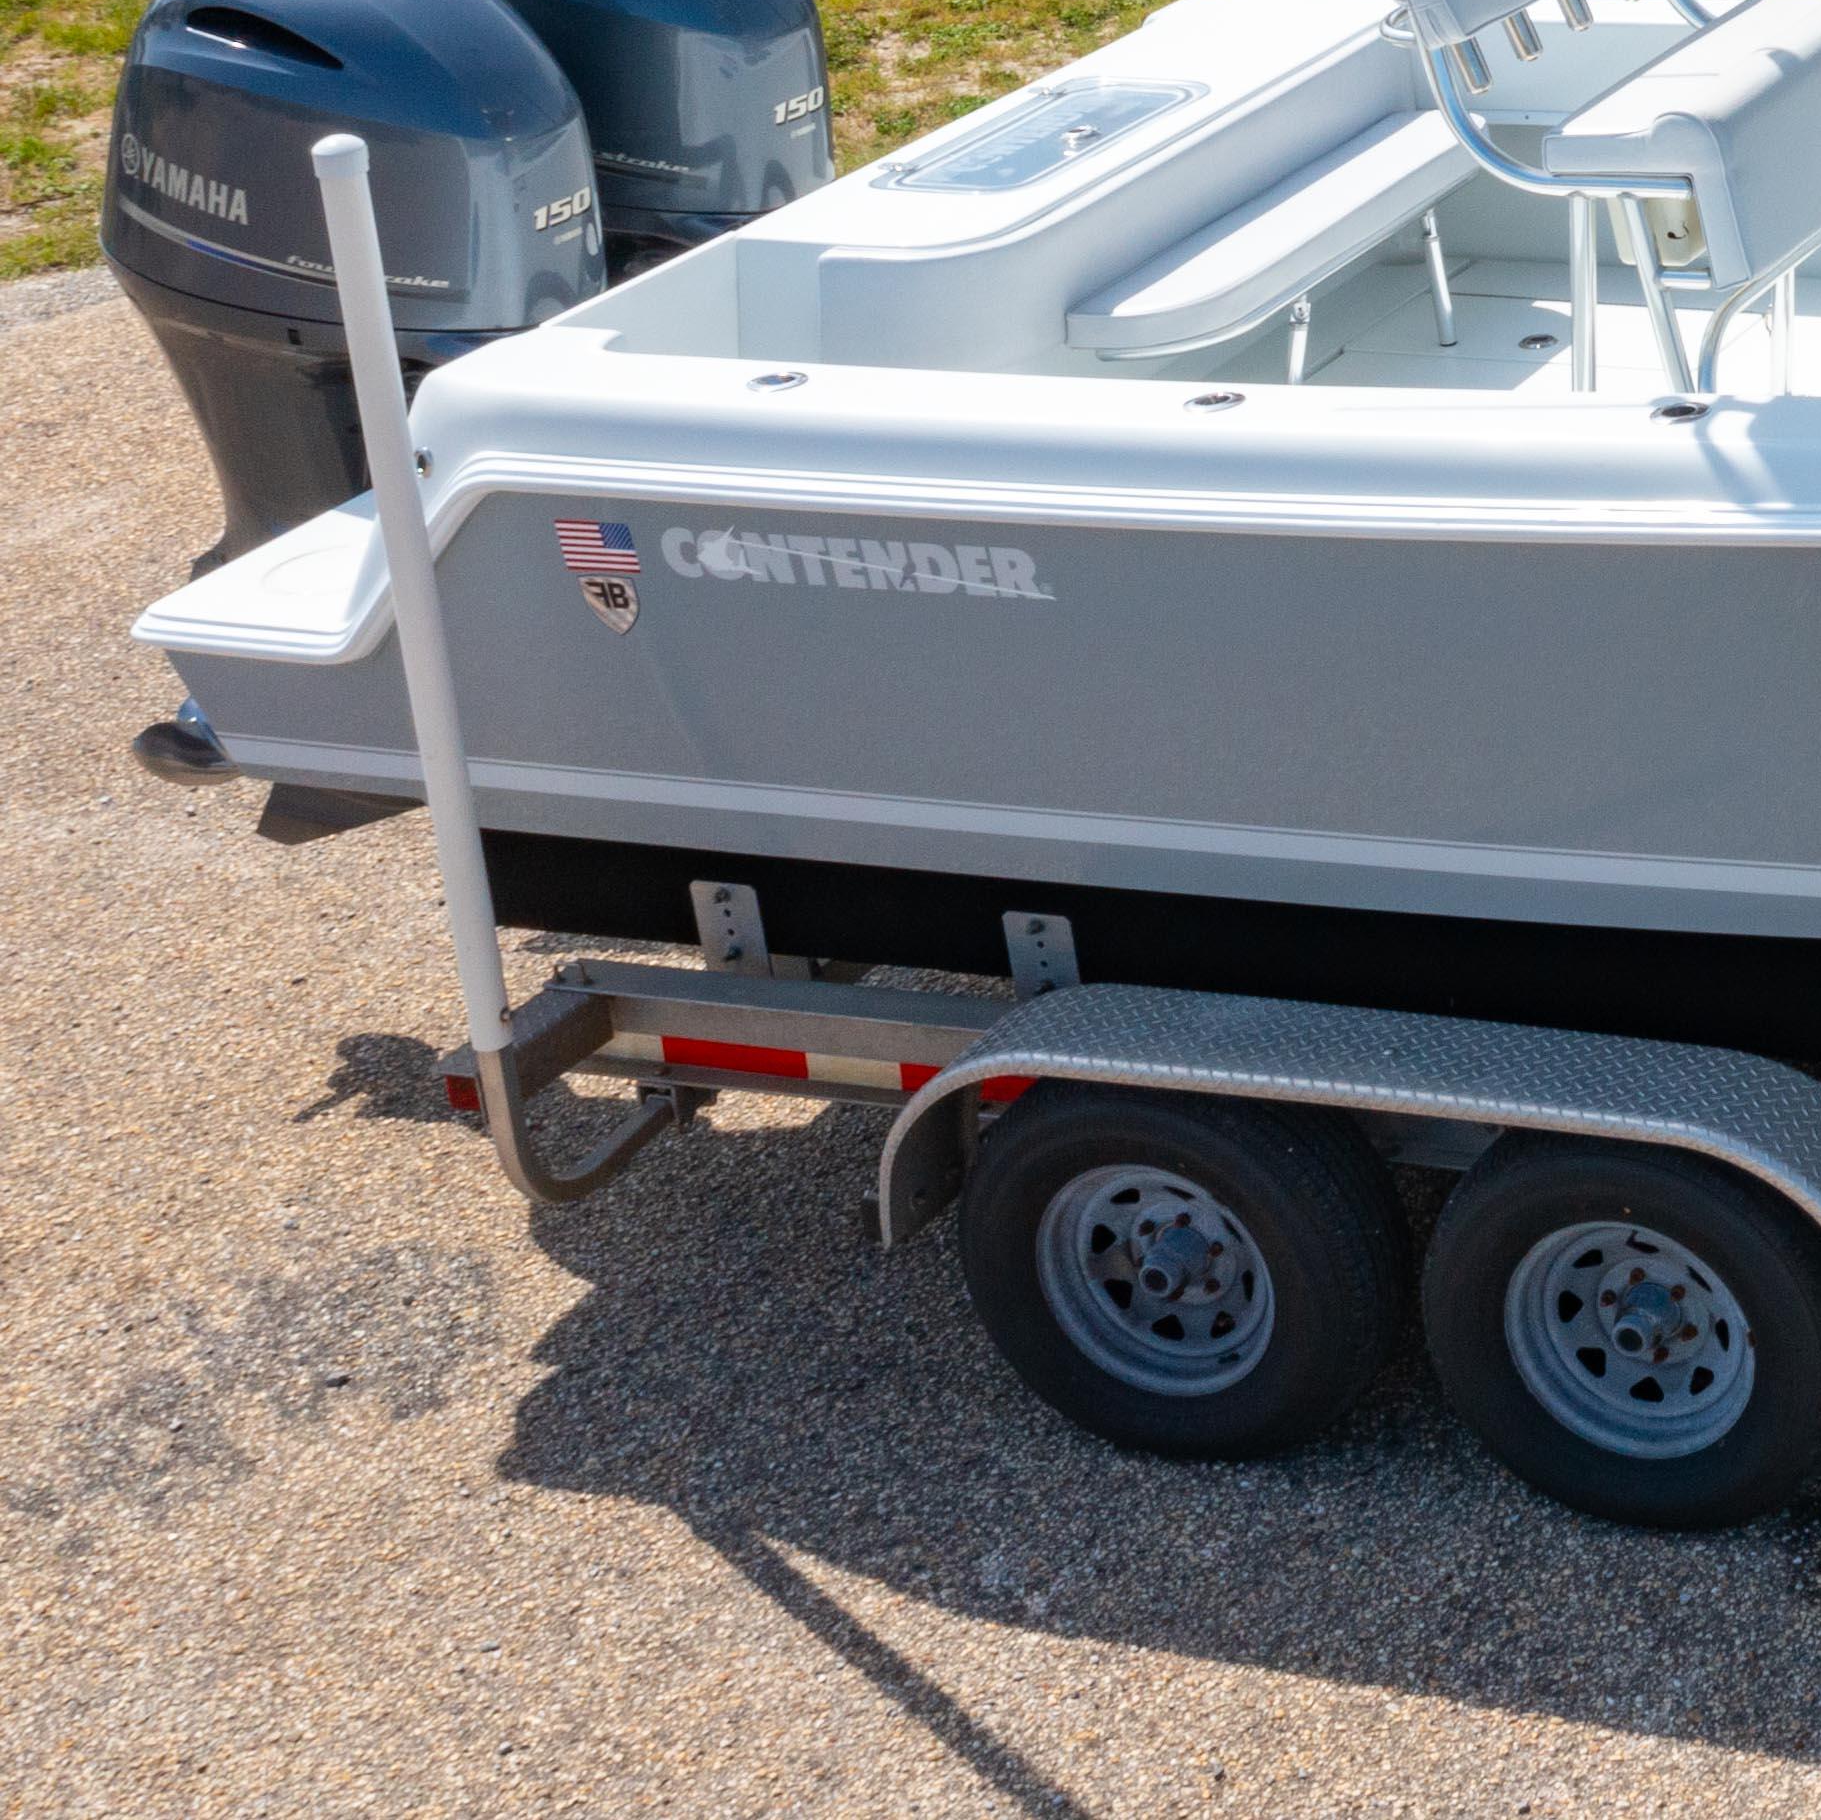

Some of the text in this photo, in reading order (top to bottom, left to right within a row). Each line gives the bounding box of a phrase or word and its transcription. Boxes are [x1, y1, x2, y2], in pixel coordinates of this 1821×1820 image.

[773, 86, 825, 126] 150
[140, 146, 249, 226] YAMAHA
[533, 186, 592, 231] 150
[660, 526, 1040, 600] CONTENDER
